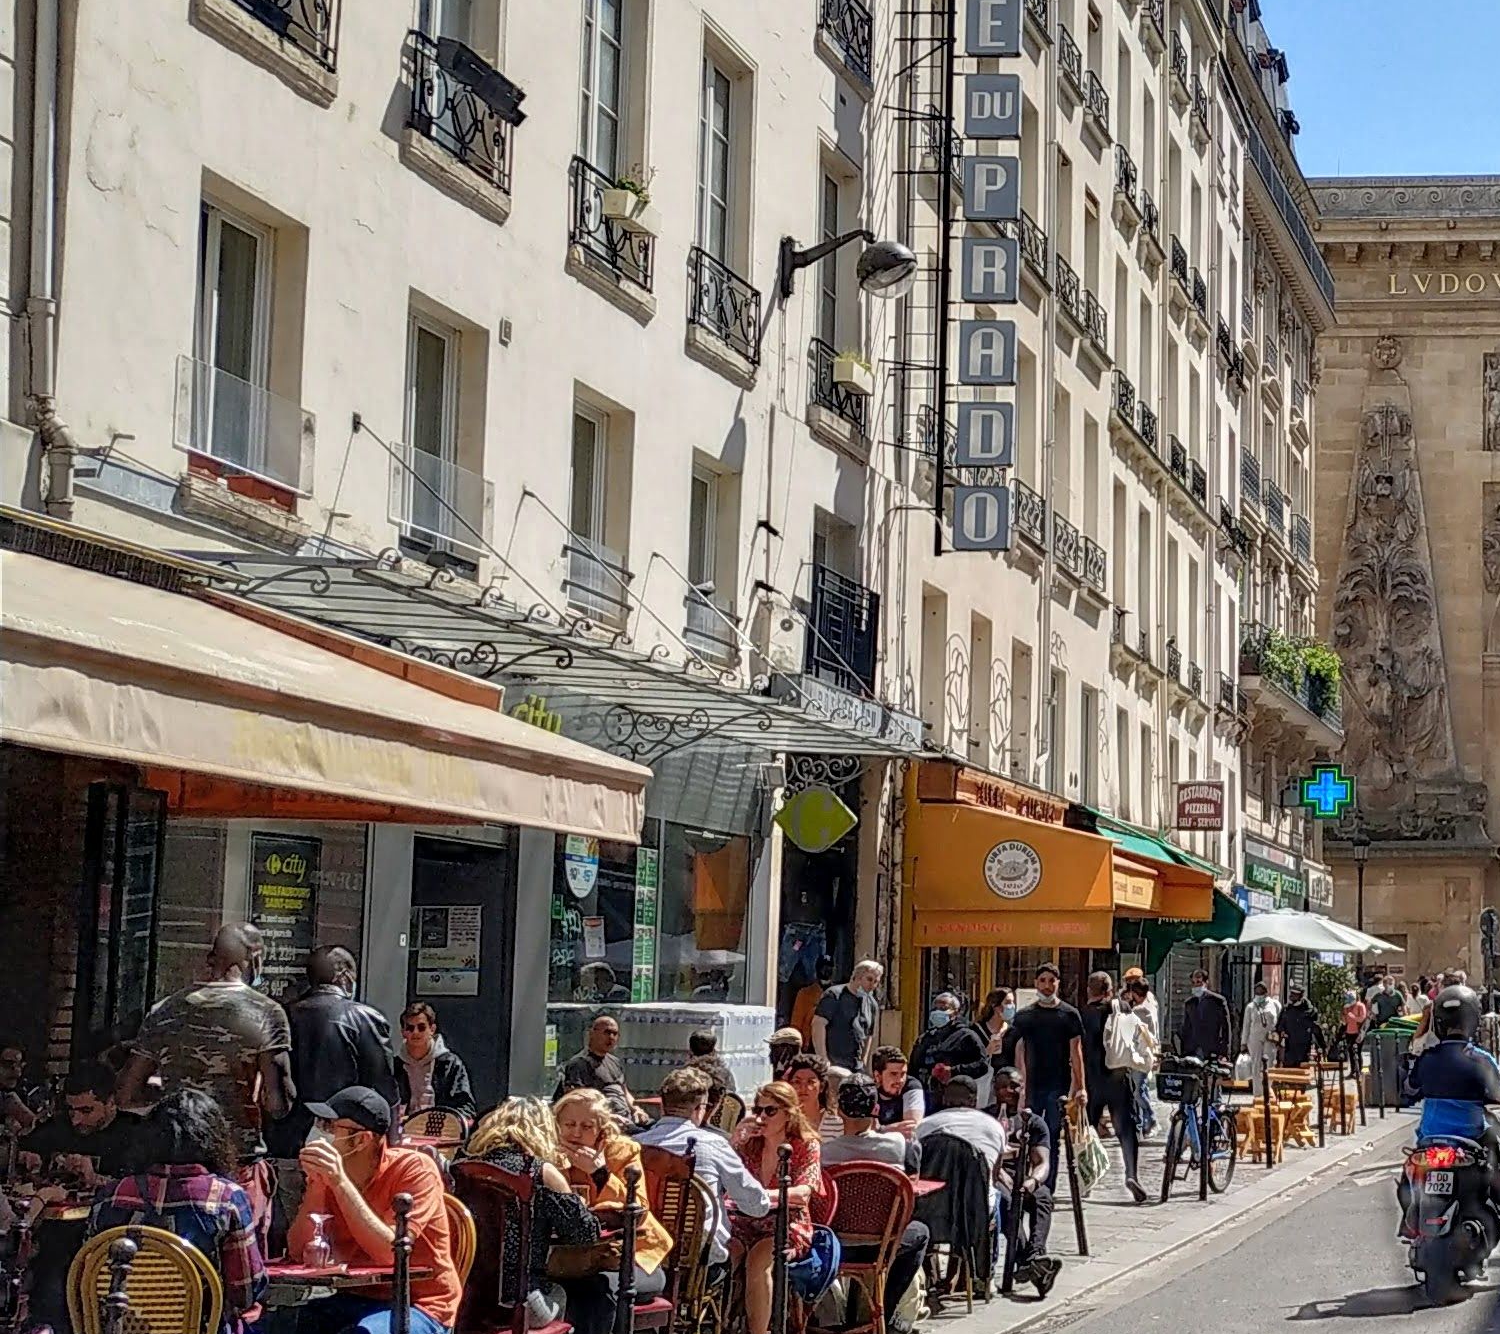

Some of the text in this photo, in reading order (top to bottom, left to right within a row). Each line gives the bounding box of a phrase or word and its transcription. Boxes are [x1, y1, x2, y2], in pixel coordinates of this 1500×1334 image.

[971, 91, 1013, 120] DU
[962, 163, 1007, 543] PRADO
[1179, 786, 1221, 804] RESTAURANT
[1184, 803, 1215, 814] PIZZERIA
[1197, 818, 1221, 827] SERVICE
[988, 845, 1008, 864] URFA
